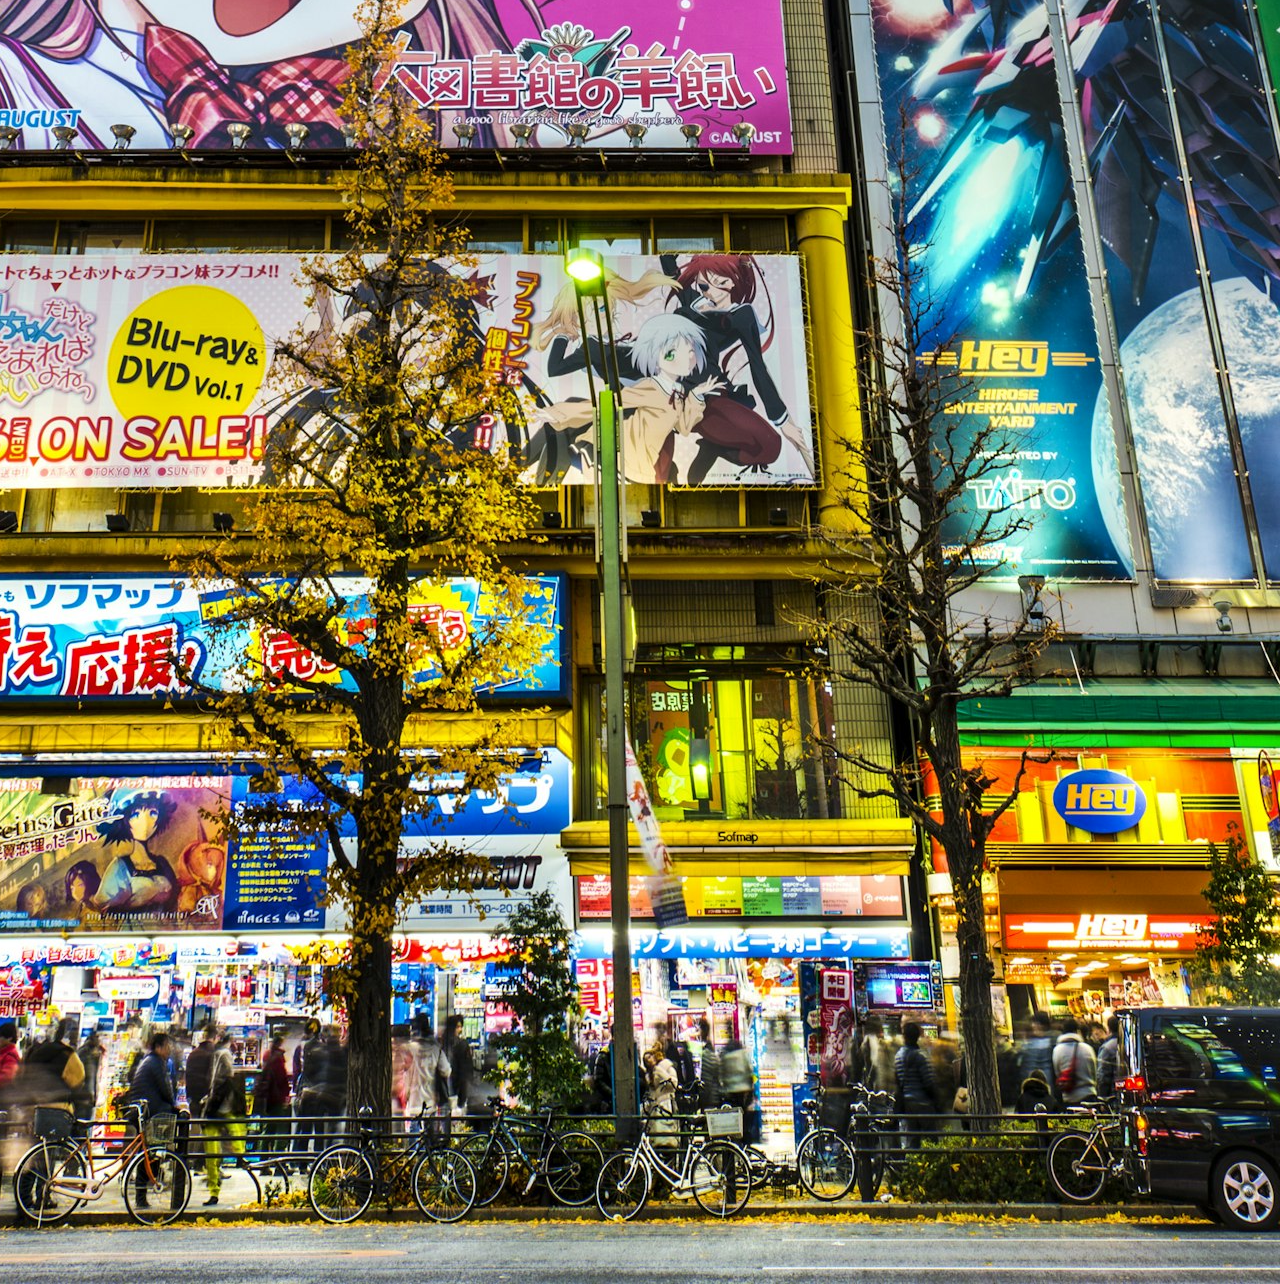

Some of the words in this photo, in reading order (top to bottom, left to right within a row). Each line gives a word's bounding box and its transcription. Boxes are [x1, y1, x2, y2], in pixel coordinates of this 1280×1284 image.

[380, 30, 778, 116] 大図書館の羊飼い
[464, 115, 493, 127] good
[498, 114, 555, 125] librarian
[558, 114, 580, 125] like
[595, 115, 624, 127] good
[628, 114, 684, 127] shepherd
[959, 340, 1049, 377] Hey
[116, 357, 190, 391] DVD
[195, 377, 244, 402] Vol.1
[979, 388, 1039, 401] HIROSE
[944, 402, 1077, 415] ENTERTAINMENT
[989, 416, 1036, 428] YARD
[38, 416, 112, 463] ON
[120, 415, 269, 462] SALE!
[1041, 451, 1058, 460] BY
[93, 466, 131, 477] TOKYO
[133, 466, 150, 477] MX
[966, 469, 1077, 510] TAITO
[26, 583, 186, 610] ソフマップ
[1065, 783, 1137, 816] Hey
[718, 831, 759, 844] Sofmap
[1075, 914, 1148, 940] Hey
[826, 974, 848, 987] 本日
